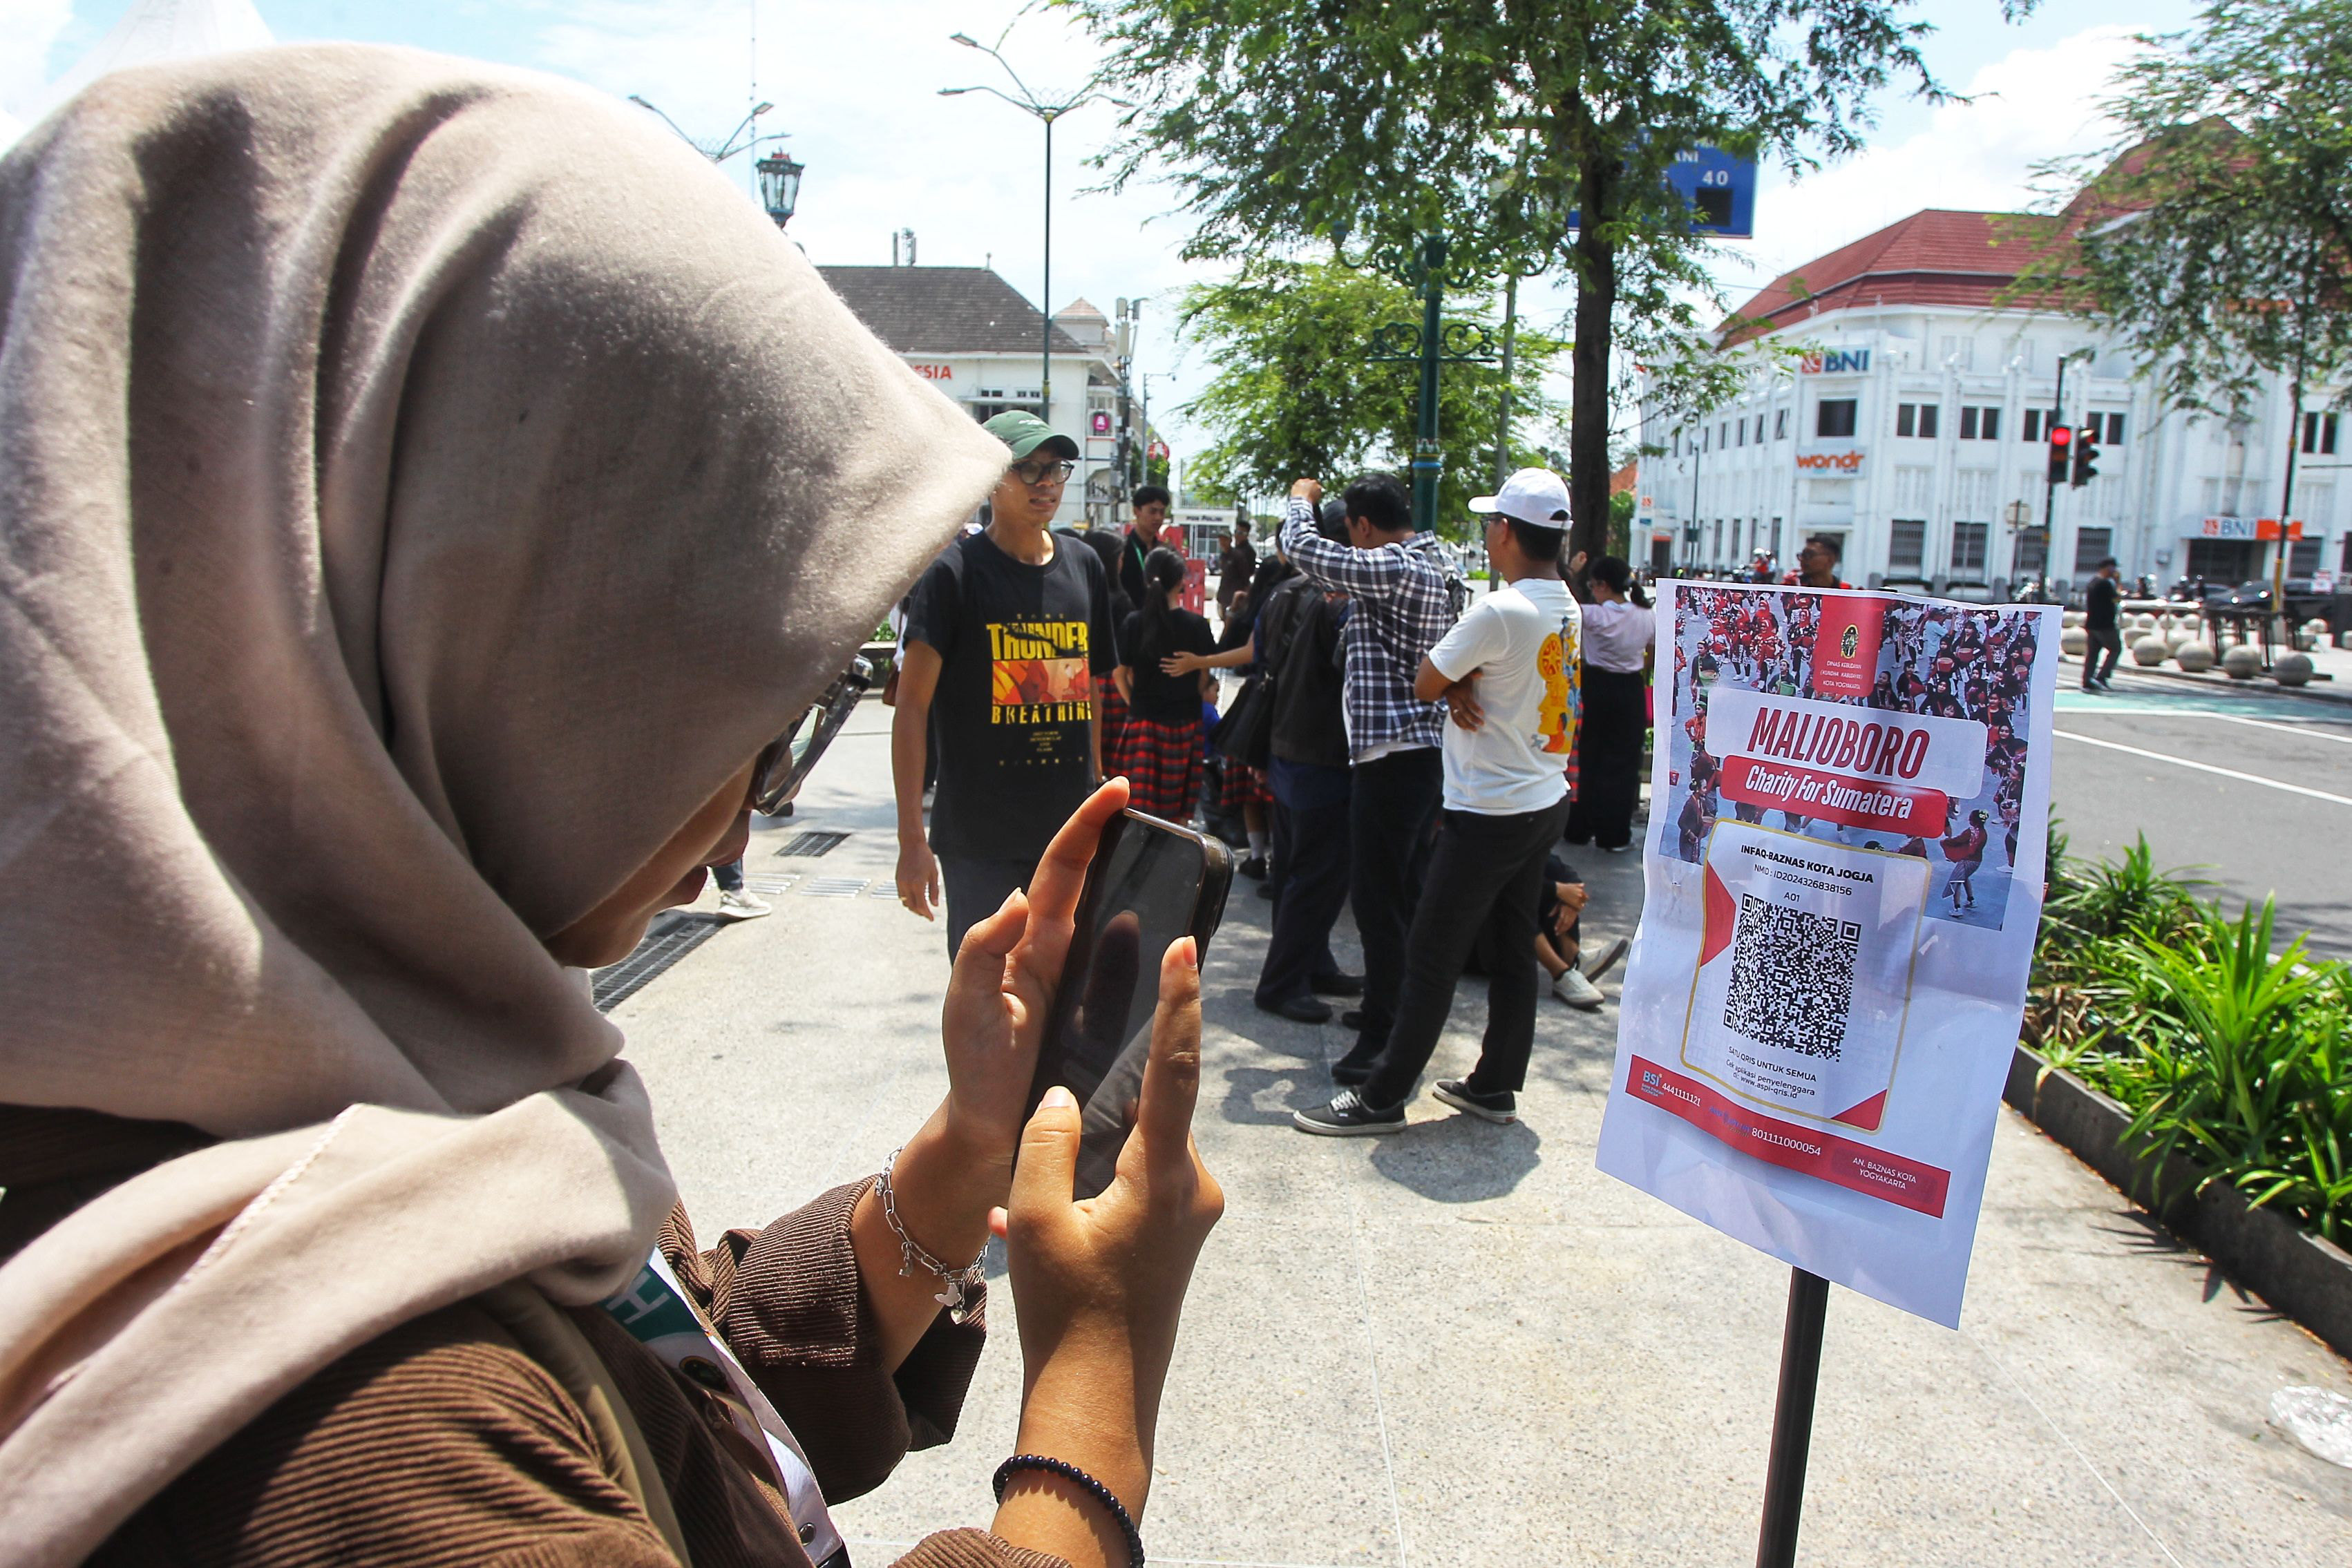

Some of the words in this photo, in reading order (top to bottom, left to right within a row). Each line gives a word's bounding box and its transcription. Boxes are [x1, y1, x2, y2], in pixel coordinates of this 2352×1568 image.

[1824, 350, 1870, 373] BNI
[1796, 451, 1865, 469] wondr
[2221, 519, 2255, 536] BNI
[987, 622, 1088, 660] THUNDER
[1745, 765, 1799, 803] Charity
[1795, 774, 1825, 803] For
[1821, 779, 1913, 819] Sumatera
[1741, 845, 1805, 870] INFAQ-BAZNAS
[1806, 861, 1835, 877] KOTA
[1837, 868, 1874, 884] JOGJA
[1773, 870, 1852, 896] ID2024326838156
[1784, 892, 1800, 902] A01
[1729, 1046, 1741, 1059] SATU
[1741, 1053, 1756, 1066] QRIS
[1756, 1060, 1785, 1074] UNTUK
[1785, 1068, 1817, 1082] SEMUA
[1642, 1070, 1660, 1087] BSI
[1726, 1058, 1734, 1069] Cek
[1734, 1064, 1756, 1080] aplikasi
[1757, 1074, 1815, 1096] penyelenggara
[1740, 1075, 1797, 1099] www.aspi-qris.id
[1662, 1082, 1702, 1107] 4441111121
[1752, 1127, 1821, 1156] 801111000054
[1852, 1157, 1866, 1167] AN.
[1867, 1161, 1897, 1176] BAZNAS
[1897, 1171, 1917, 1183] KOTA
[1859, 1168, 1906, 1189] YOGYAKARTA
